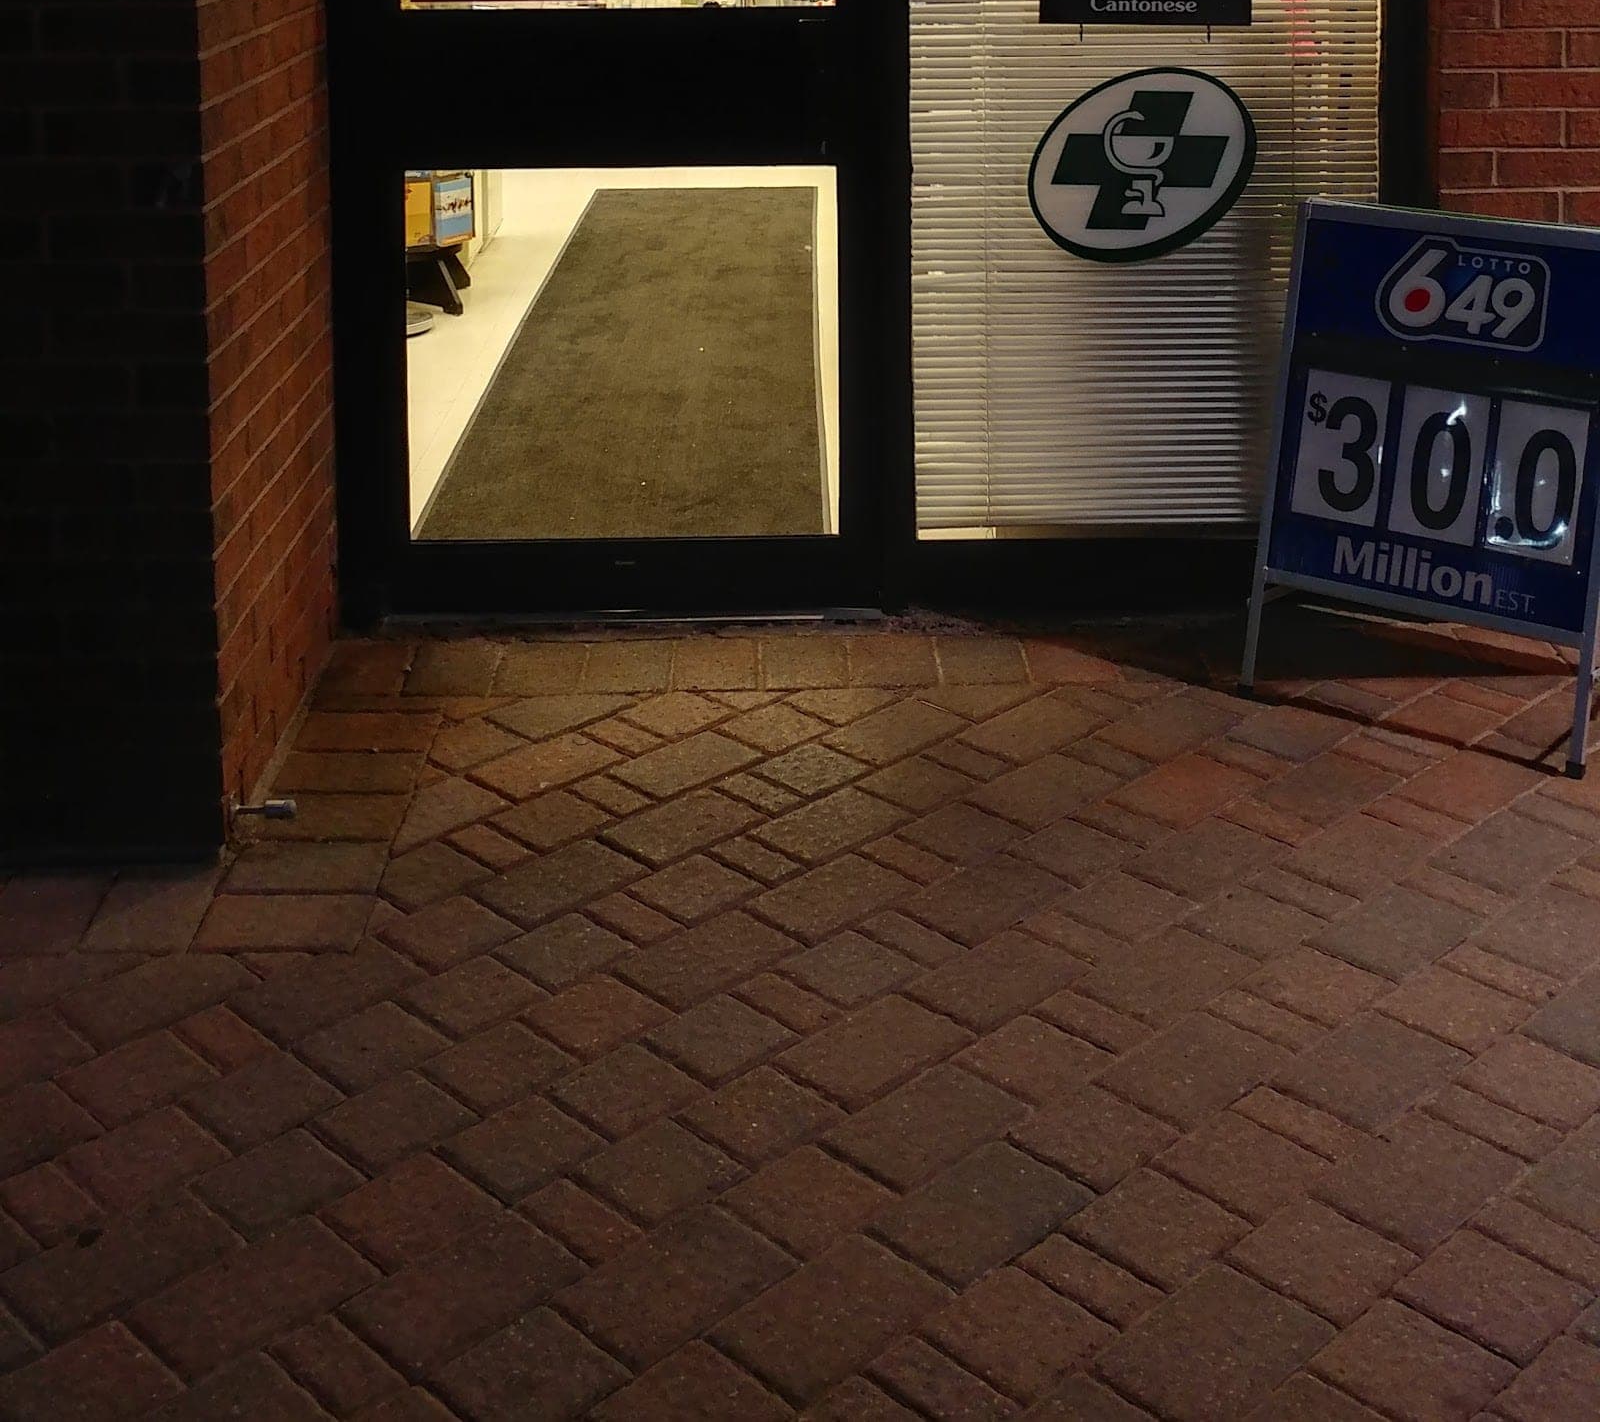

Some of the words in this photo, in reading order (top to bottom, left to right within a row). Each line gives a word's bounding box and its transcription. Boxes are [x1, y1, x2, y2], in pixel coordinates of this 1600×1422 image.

[1389, 248, 1536, 338] 649
[1457, 254, 1532, 275] LOTTO
[1333, 536, 1493, 605] Million
[1495, 588, 1536, 615] EST.
